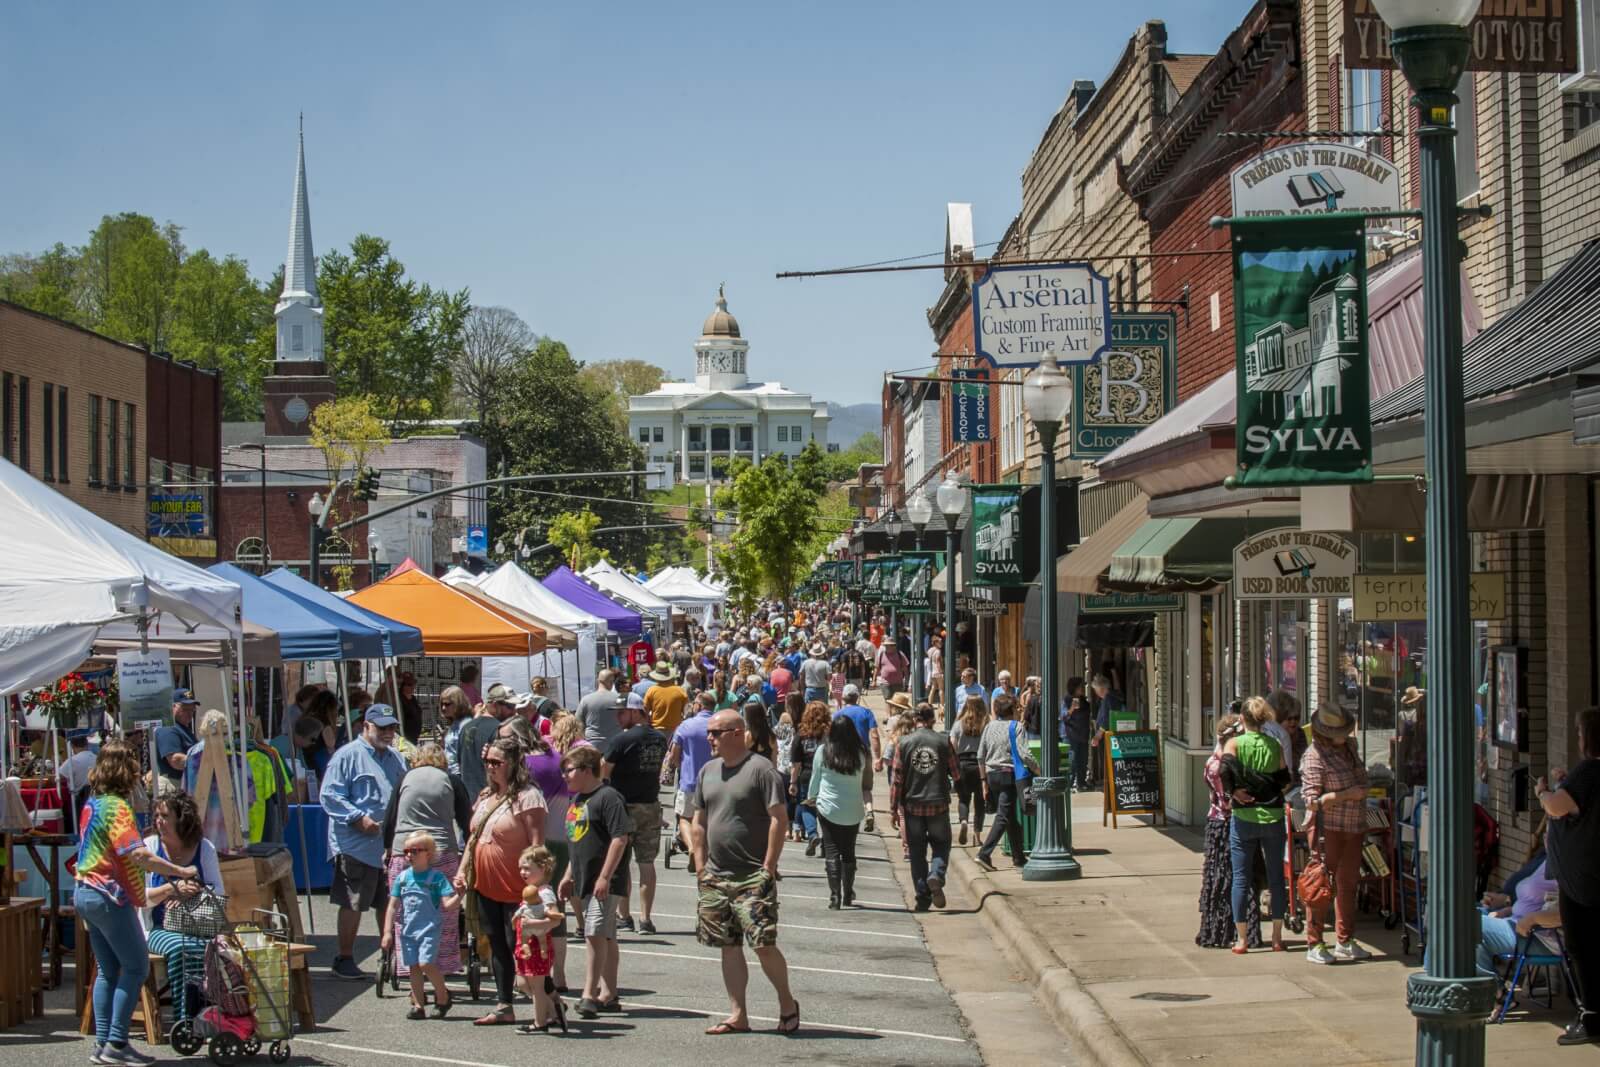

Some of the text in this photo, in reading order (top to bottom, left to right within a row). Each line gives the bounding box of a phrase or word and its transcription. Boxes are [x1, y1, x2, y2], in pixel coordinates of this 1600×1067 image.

[1240, 149, 1392, 189] FRIENDS OF THE LIBRARY
[1019, 274, 1062, 289] The
[984, 278, 1097, 310] Arsenal
[982, 310, 1103, 337] Custom Framing
[998, 334, 1089, 354] & Fine Art
[1094, 351, 1149, 418] B
[1245, 425, 1362, 453] SYLVA
[1240, 532, 1352, 561] FRIENDS OF THE LIBRARY
[975, 562, 1020, 573] SYLVA
[1242, 576, 1351, 594] USED BOOK STORE
[1364, 576, 1414, 594] terri
[902, 599, 930, 607] SYLVA
